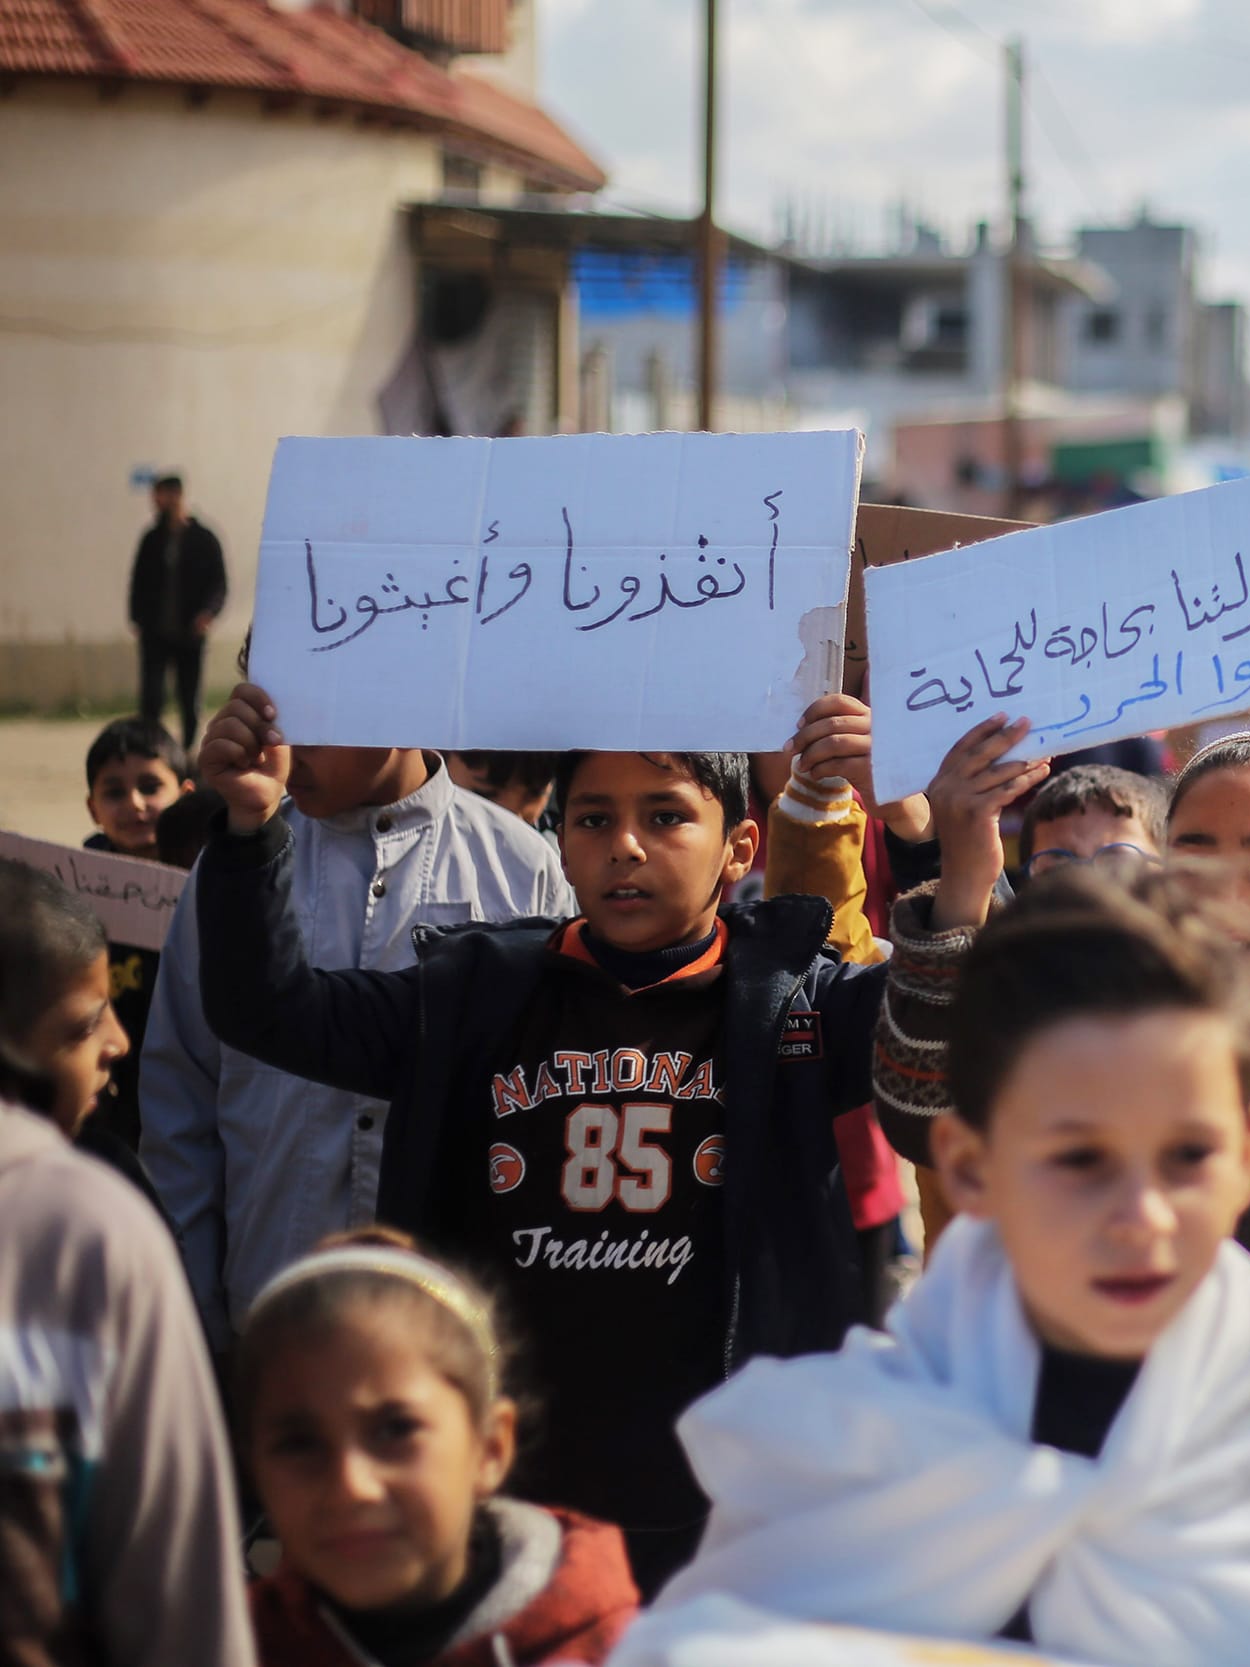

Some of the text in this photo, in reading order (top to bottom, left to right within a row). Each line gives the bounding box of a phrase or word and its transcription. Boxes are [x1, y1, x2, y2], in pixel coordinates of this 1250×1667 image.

[304, 490, 784, 653] أنقذونا وأغيثونا
[906, 607, 1037, 713] للحماية
[1044, 602, 1156, 669] بحاجة
[1027, 650, 1182, 745] الحرب
[780, 1043, 813, 1056] GER
[787, 1018, 813, 1029] MY
[491, 1047, 727, 1118] NATIONA
[561, 1102, 673, 1213] 85
[512, 1225, 694, 1285] Training
